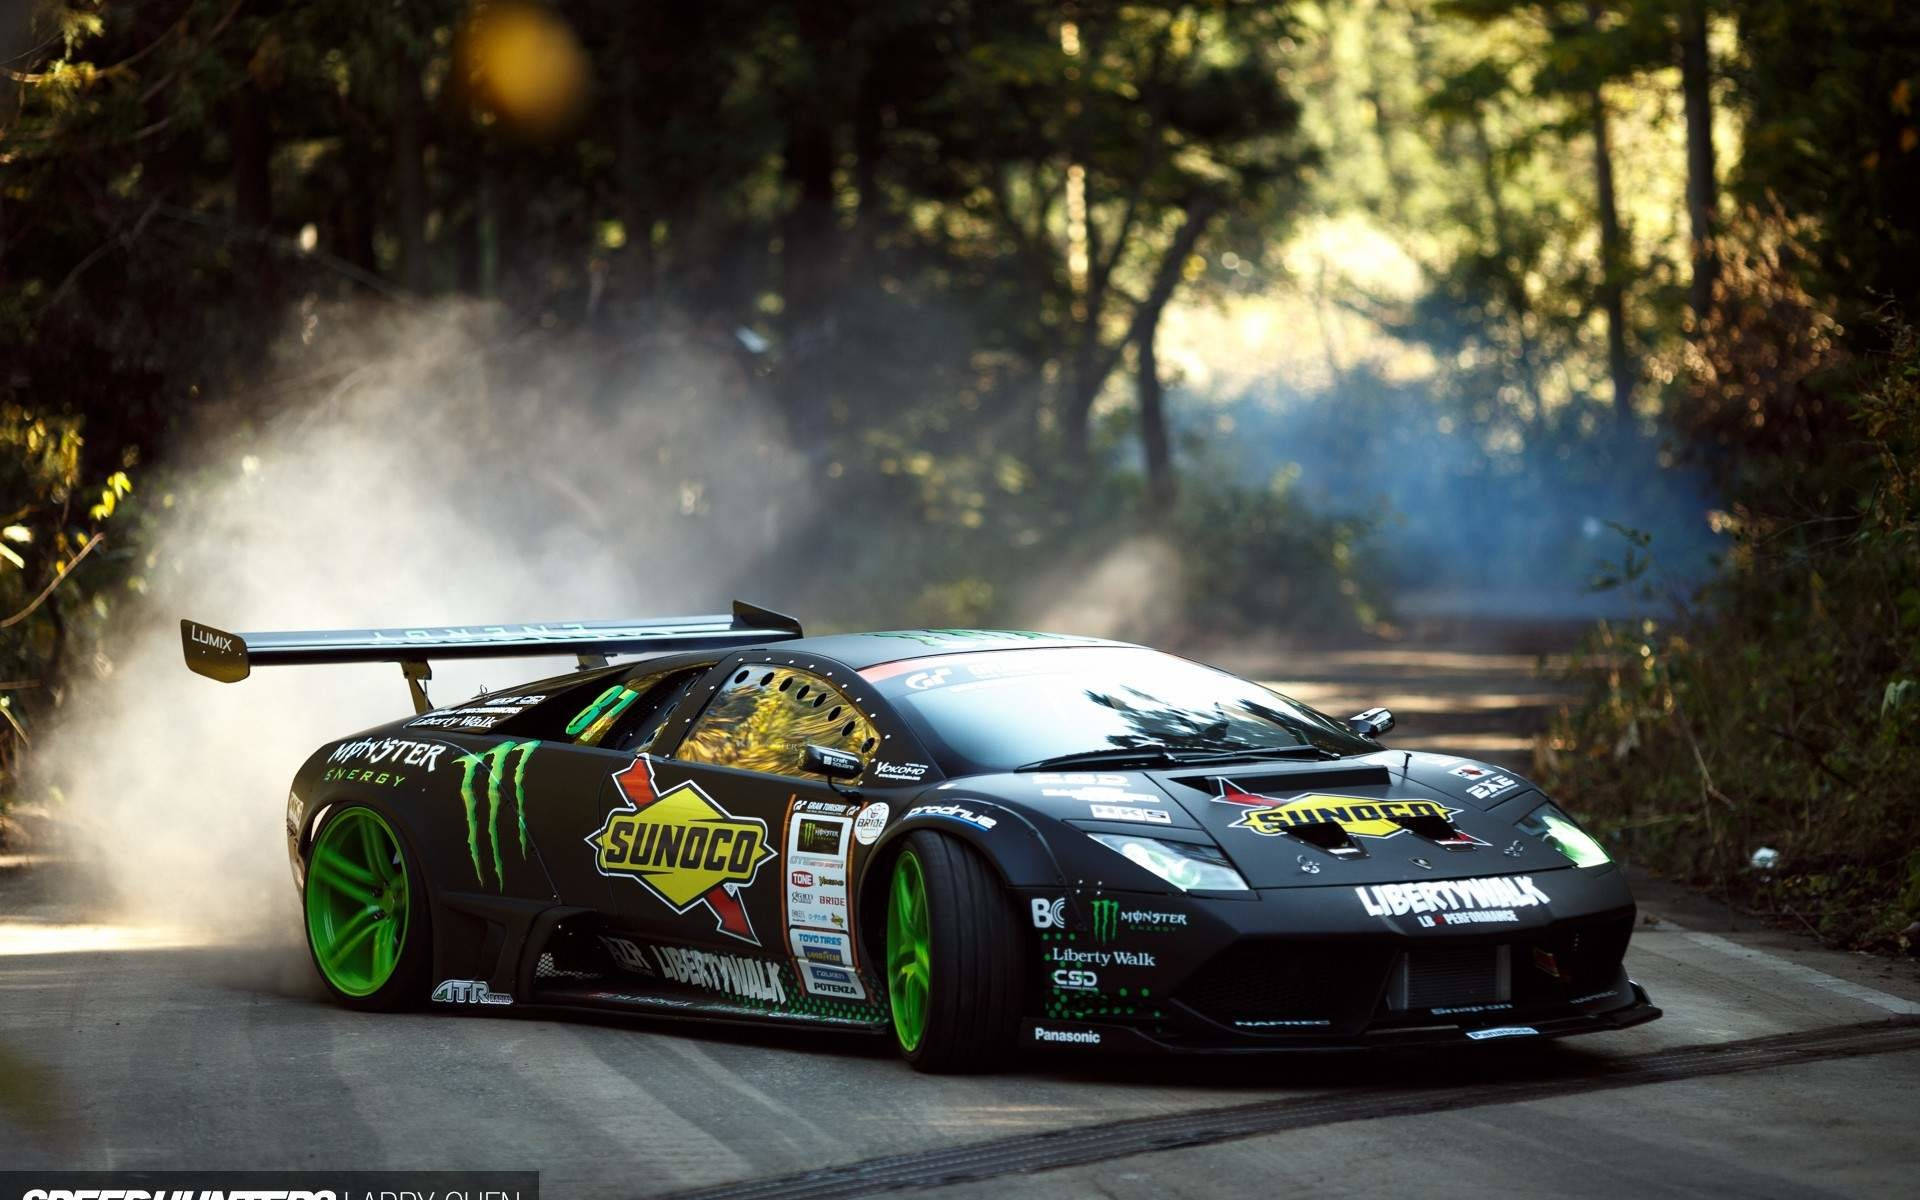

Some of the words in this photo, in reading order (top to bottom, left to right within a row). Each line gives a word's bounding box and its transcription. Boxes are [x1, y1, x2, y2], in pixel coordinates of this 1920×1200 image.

[191, 625, 232, 652] LUMIX
[326, 737, 446, 773] MONSTER
[323, 768, 406, 787] ENERGY
[1465, 775, 1516, 800] EXE
[857, 818, 885, 828] BRIDE
[1257, 803, 1437, 829] SUNOCO
[606, 821, 760, 874] SUNOCO
[793, 873, 812, 885] TONE
[819, 895, 845, 906] BRIDE
[1354, 876, 1551, 917] LIBERTYWALK
[1121, 910, 1188, 925] MONSTER
[798, 933, 819, 944] TOYO
[819, 935, 842, 946] TIRES
[1052, 947, 1112, 967] Liberty
[1112, 951, 1157, 967] Walk
[649, 945, 786, 1004] LIBERTYWALK
[1053, 969, 1098, 987] CSD
[814, 982, 857, 995] POTENZA
[1034, 1027, 1101, 1044] Panasonic
